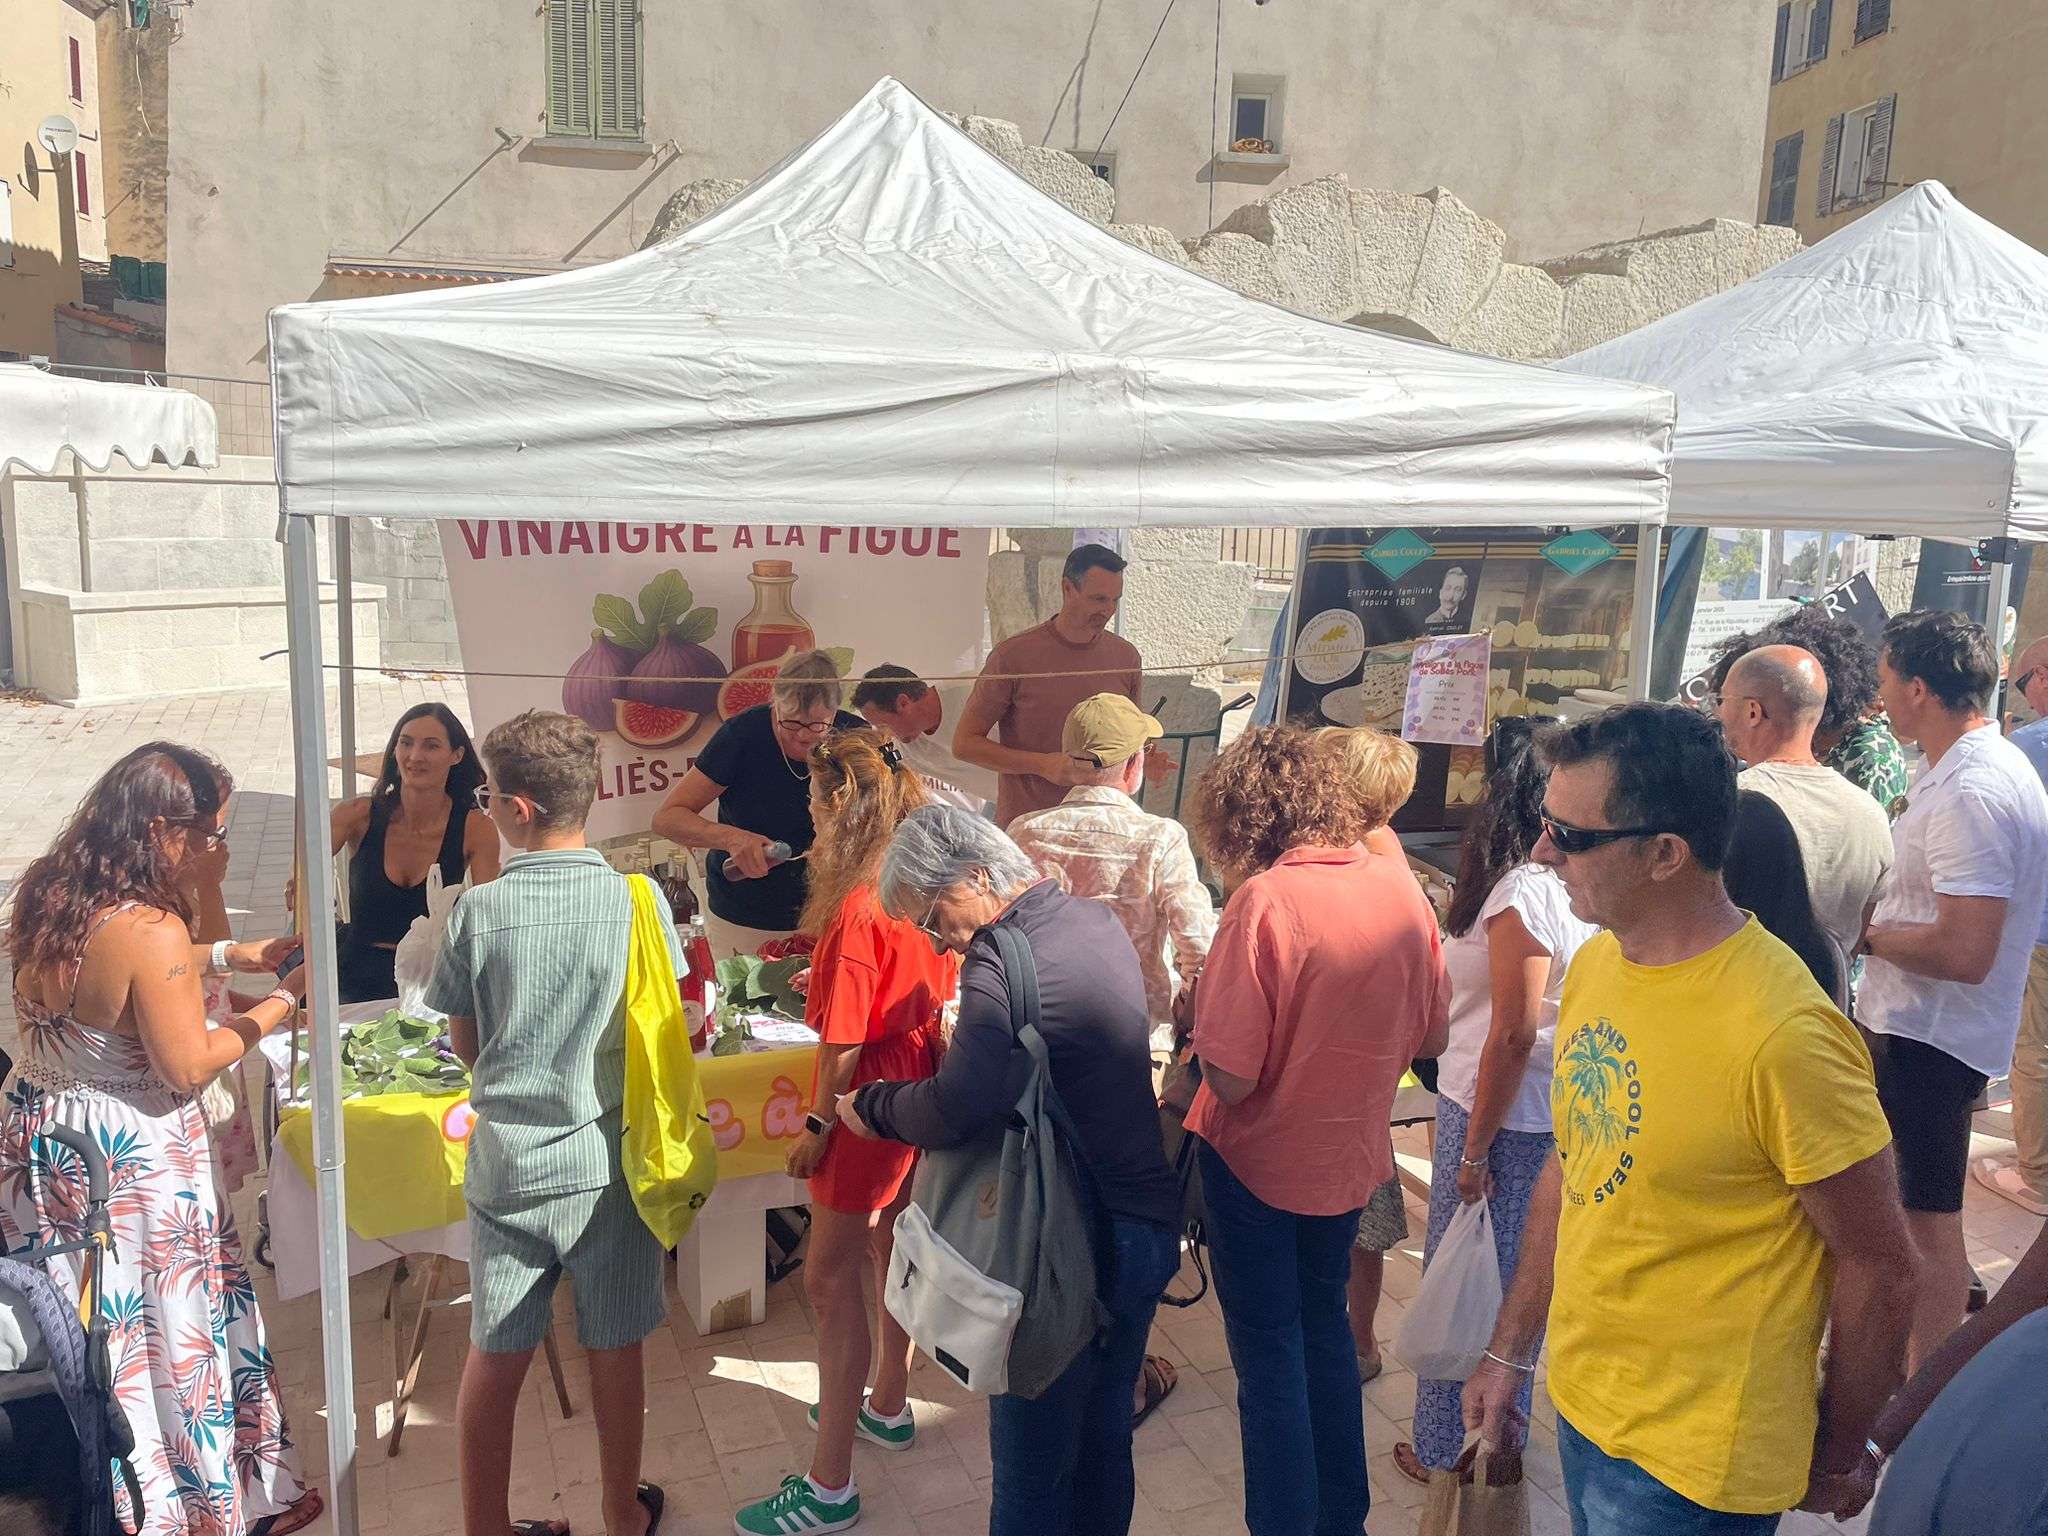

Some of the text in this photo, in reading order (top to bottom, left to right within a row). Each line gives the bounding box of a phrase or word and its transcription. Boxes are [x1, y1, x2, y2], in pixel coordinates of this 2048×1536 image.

[457, 519, 718, 560] VINAIGRE
[766, 525, 805, 547] LA
[819, 526, 961, 558] FIGUE
[1346, 588, 1394, 598] Entreprise
[1360, 598, 1389, 607] depuis
[1593, 1021, 1628, 1054] AND
[1624, 1059, 1643, 1140] COOL
[1594, 1151, 1634, 1204] SEAS
